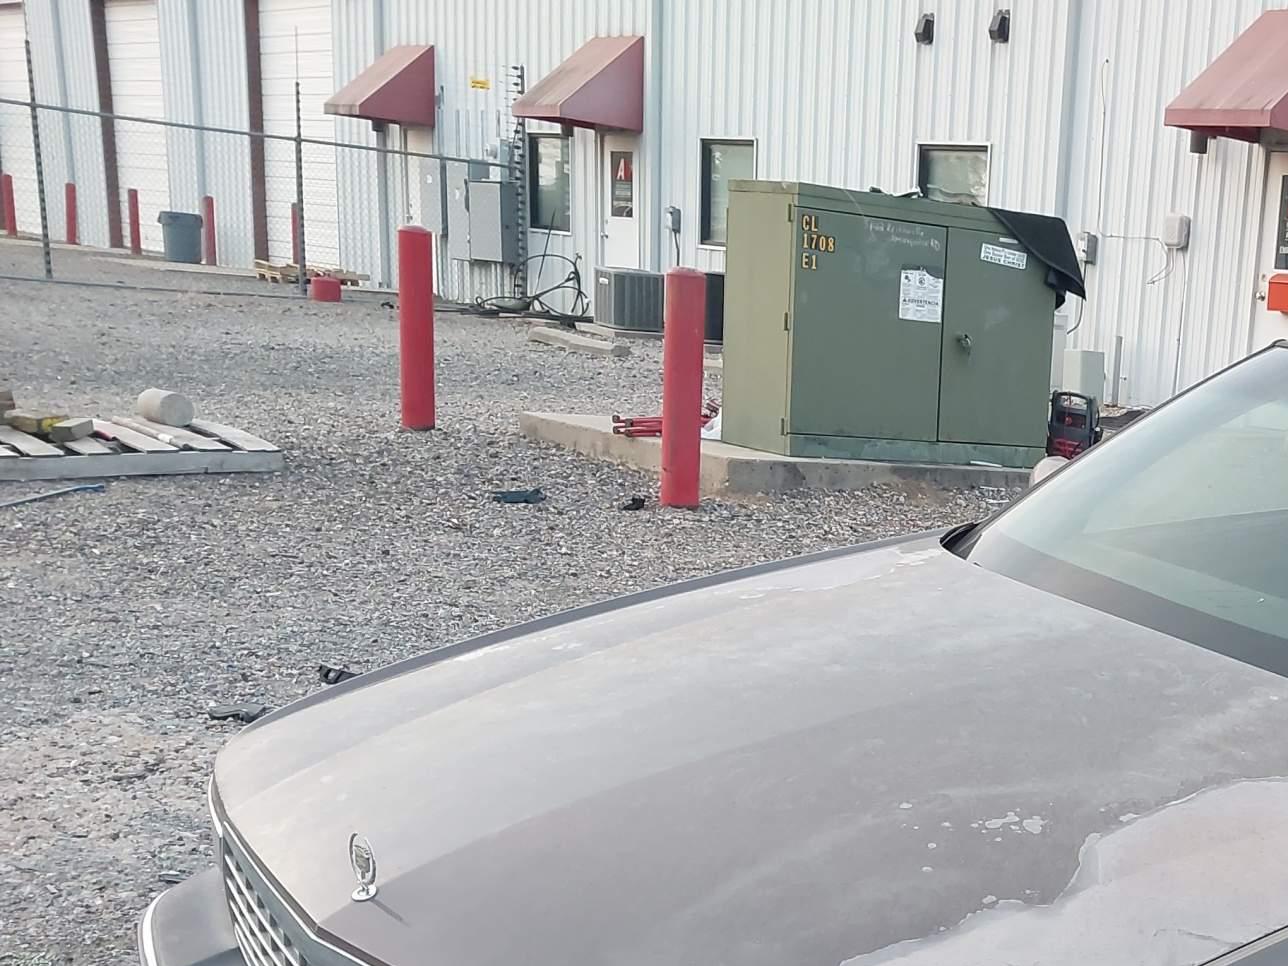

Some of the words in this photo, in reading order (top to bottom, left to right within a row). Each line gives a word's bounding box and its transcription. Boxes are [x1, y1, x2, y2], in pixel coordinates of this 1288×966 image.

[802, 214, 819, 232] CL
[802, 233, 835, 252] 1708
[802, 252, 817, 270] E1
